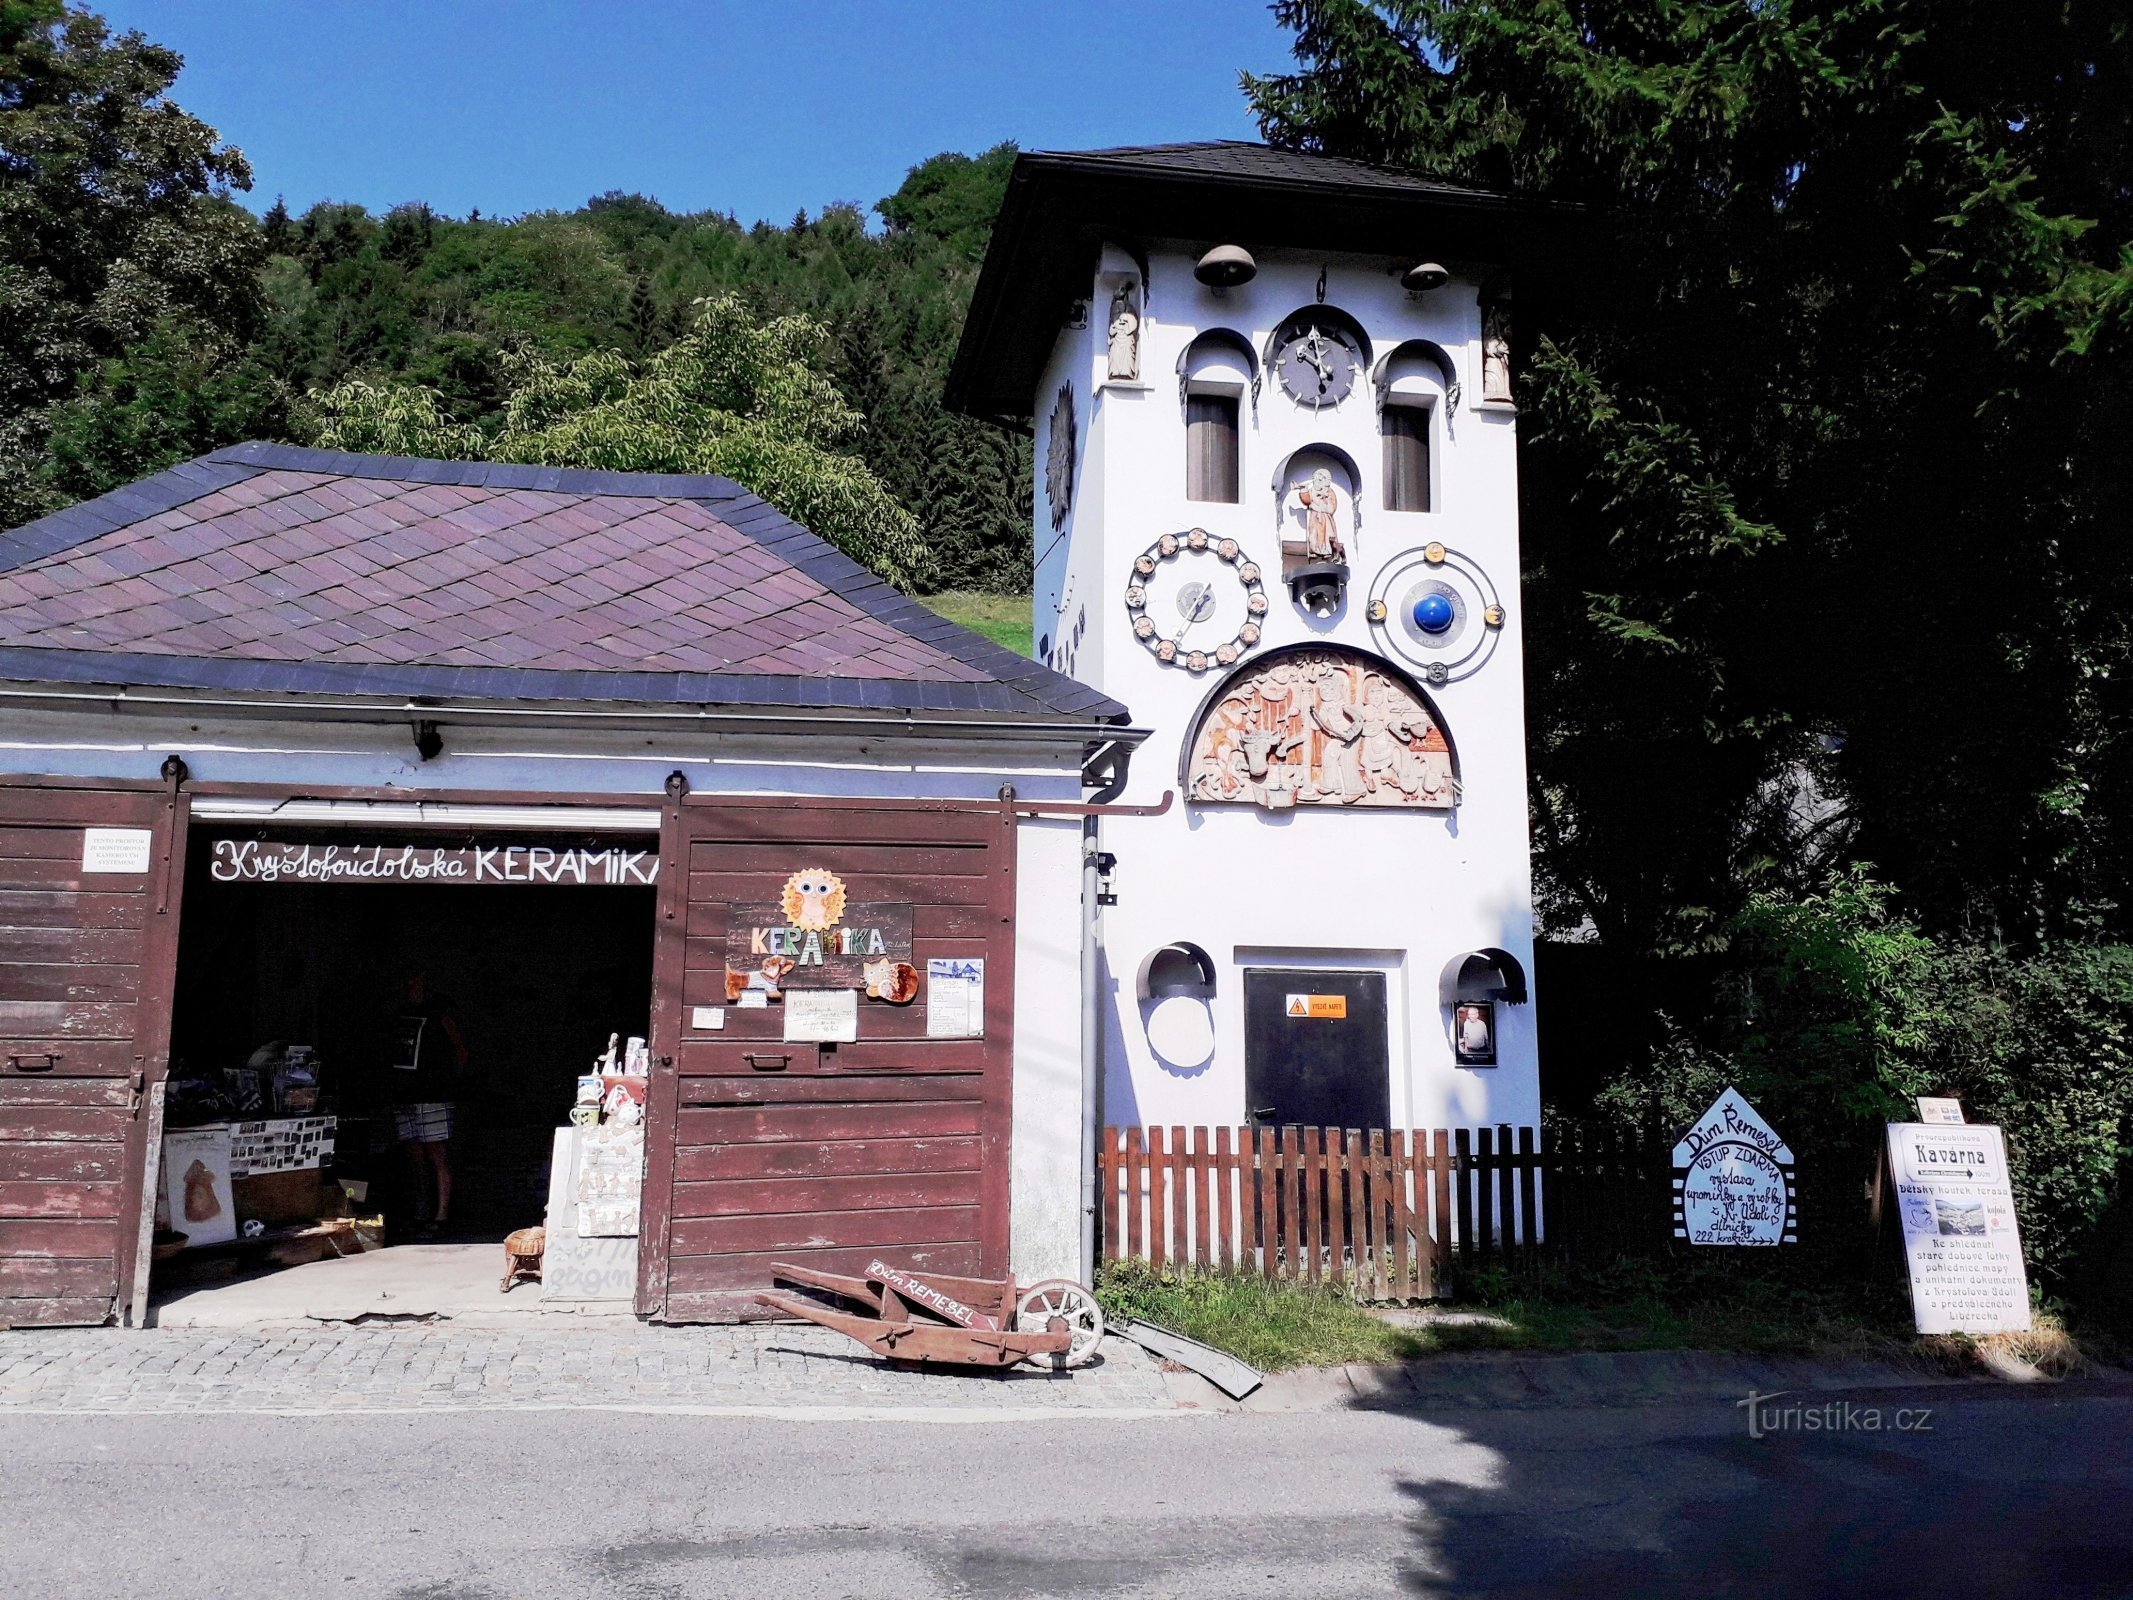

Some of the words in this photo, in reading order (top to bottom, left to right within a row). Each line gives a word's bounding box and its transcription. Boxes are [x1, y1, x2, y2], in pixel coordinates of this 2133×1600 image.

[1721, 1103, 1783, 1159] Řemesel
[1915, 1144, 1986, 1164] Kavárna
[1696, 1146, 1730, 1170] VSTUP
[1734, 1147, 1780, 1183] ZDARMA
[1899, 1184, 1934, 1196] Dětský
[1977, 1187, 2008, 1196] terasa
[1694, 1230, 1714, 1243] 222
[1932, 1239, 1946, 1248] Ke
